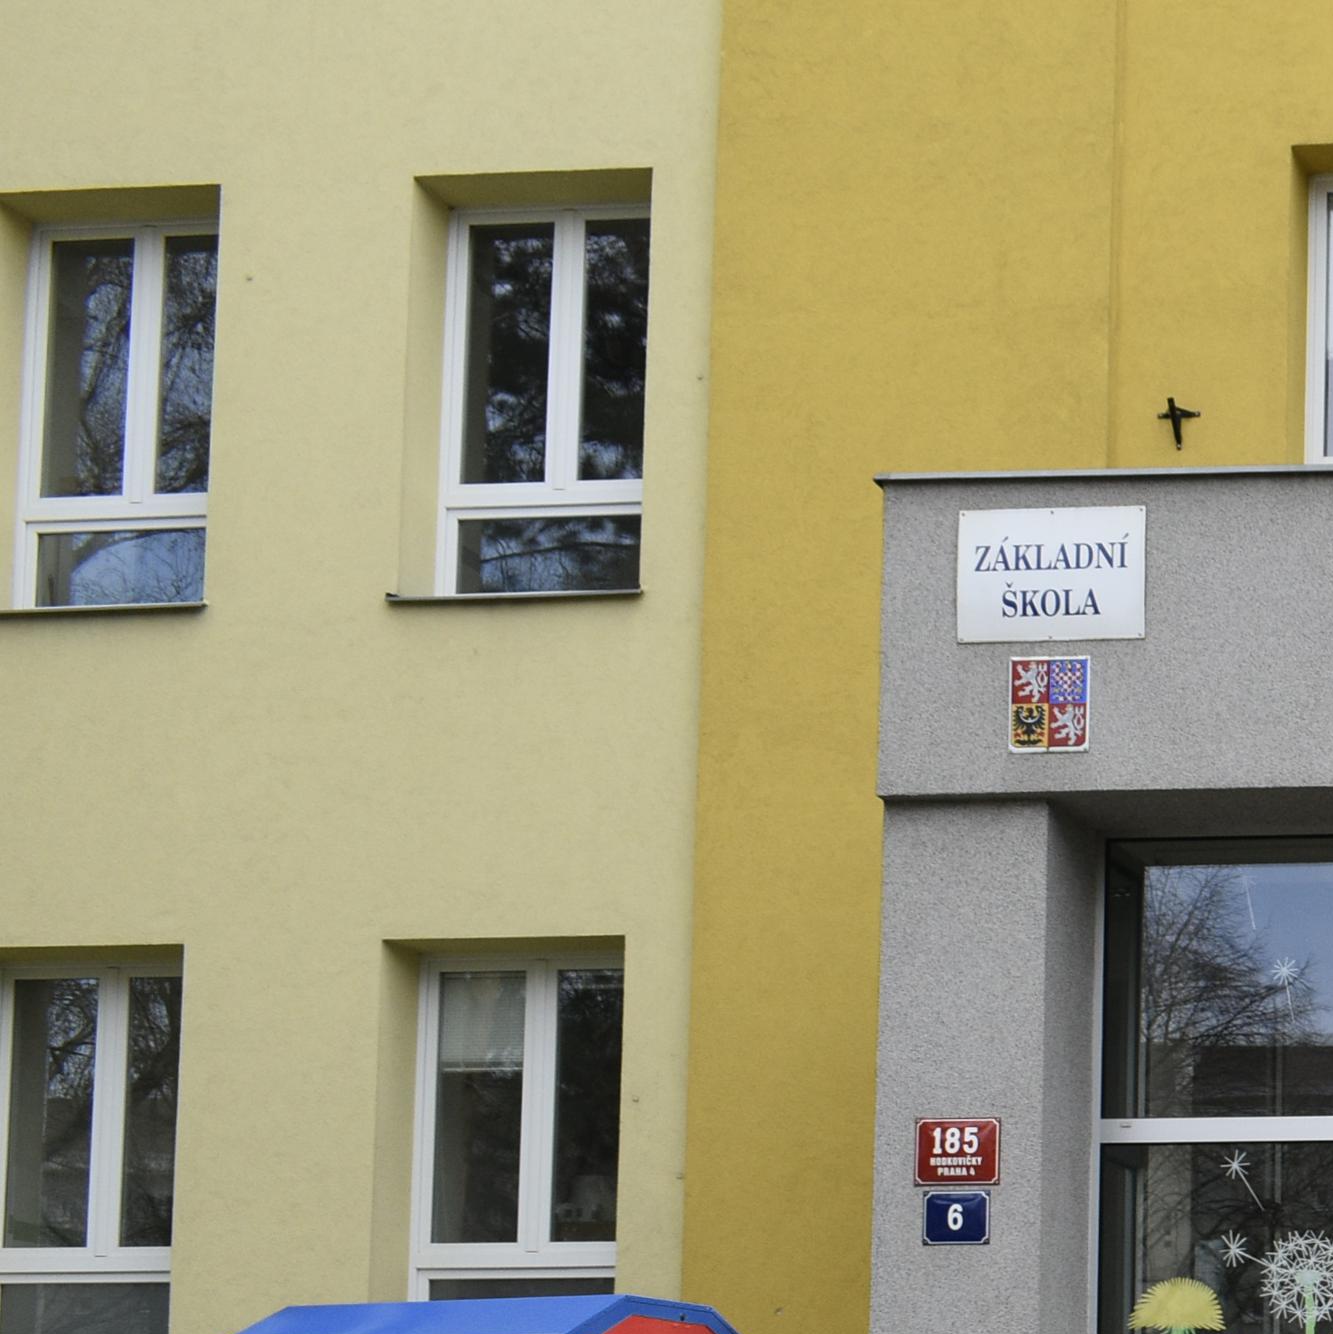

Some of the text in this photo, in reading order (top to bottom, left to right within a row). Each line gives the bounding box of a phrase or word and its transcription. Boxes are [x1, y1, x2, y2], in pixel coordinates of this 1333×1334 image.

[973, 532, 1130, 573] ZÁKLADNÍ
[1001, 582, 1102, 619] ŠKOLA
[932, 1126, 979, 1155] 185
[937, 1167, 976, 1176] PRAHA 4
[947, 1203, 964, 1231] 6
